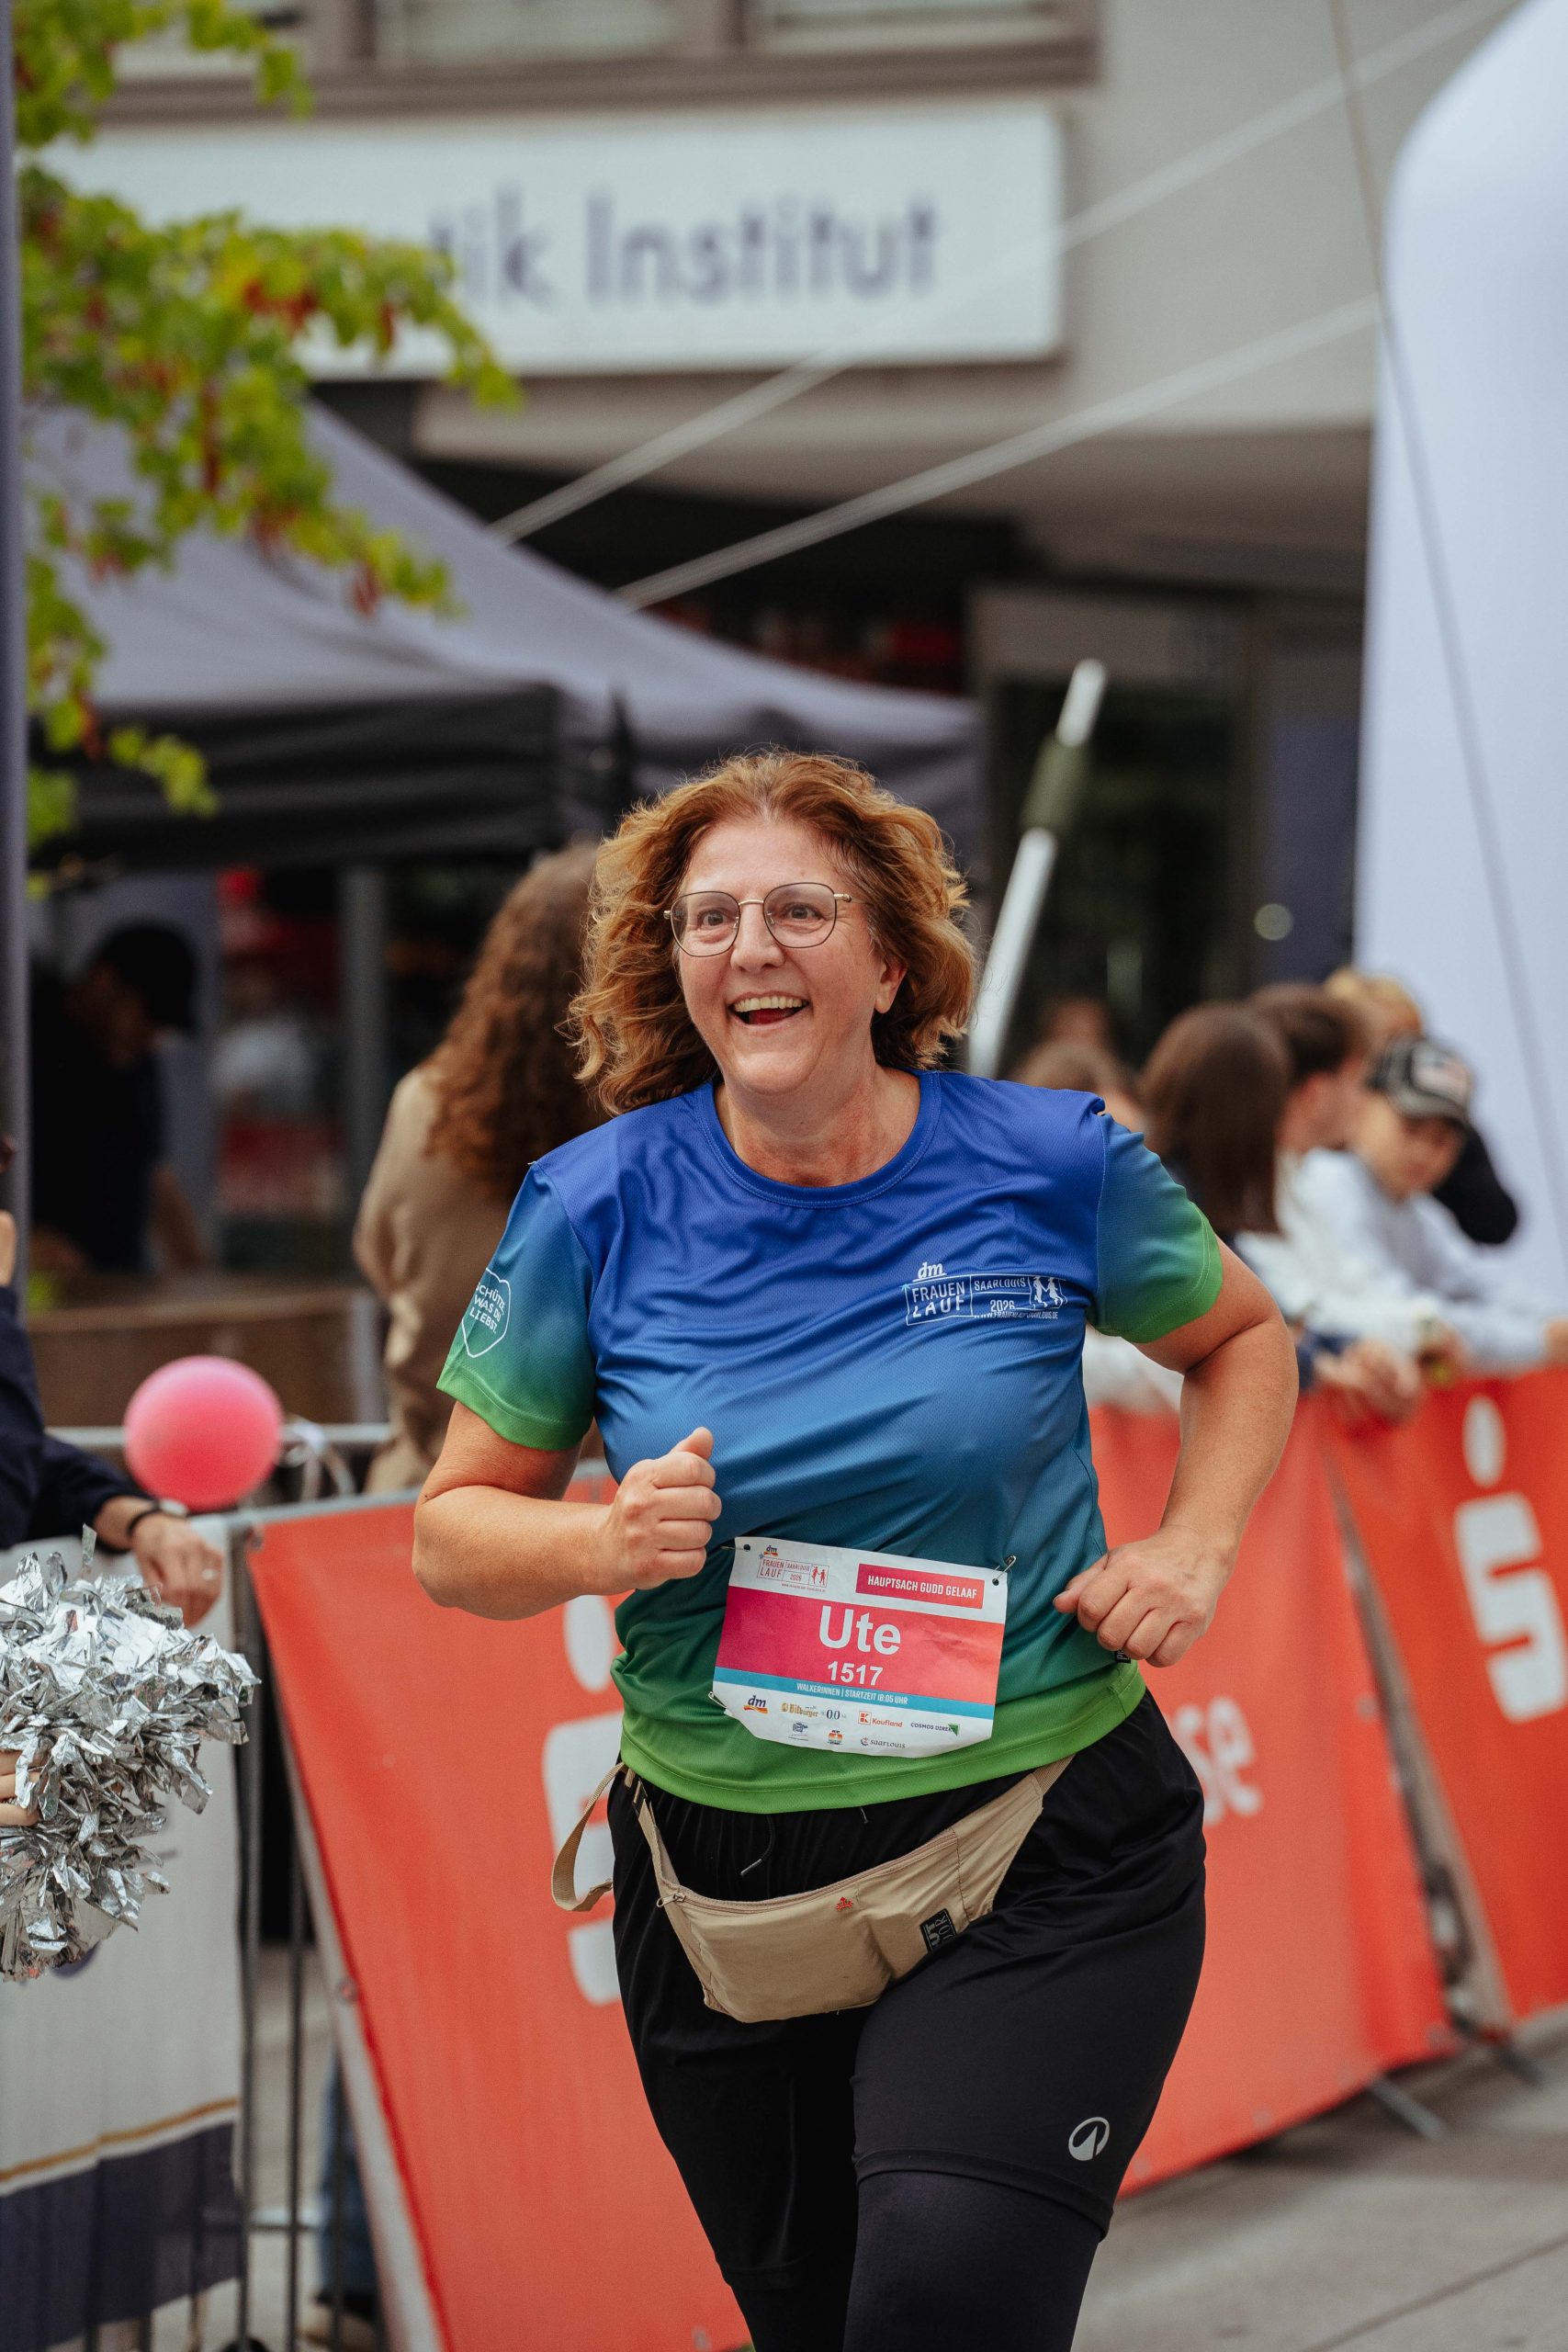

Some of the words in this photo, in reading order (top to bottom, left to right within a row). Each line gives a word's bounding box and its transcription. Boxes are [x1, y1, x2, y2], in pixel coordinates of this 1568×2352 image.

[584, 186, 937, 306] Institut
[918, 1262, 943, 1279] dm
[911, 1281, 965, 1303] FRAUEN
[974, 1277, 1026, 1292] SAARLOUIS
[474, 1294, 494, 1314] WAS
[912, 1295, 964, 1318] LAUF
[990, 1299, 1015, 1312] 2026
[760, 1567, 782, 1578] LAUF
[761, 1559, 784, 1569] FRAUEN
[867, 1575, 918, 1593] HAUPTSACH
[919, 1580, 944, 1596] GUDD
[945, 1584, 977, 1600] GELAAF
[818, 1605, 902, 1656] Ute
[828, 1661, 884, 1687] 1517
[748, 1695, 766, 1708] dm
[796, 1682, 840, 1697] WALKERINNEN
[845, 1690, 876, 1702] STARTZEIT
[895, 1695, 908, 1705] UHR
[873, 1718, 902, 1727] Kaufland
[910, 1723, 934, 1731] COSMOS
